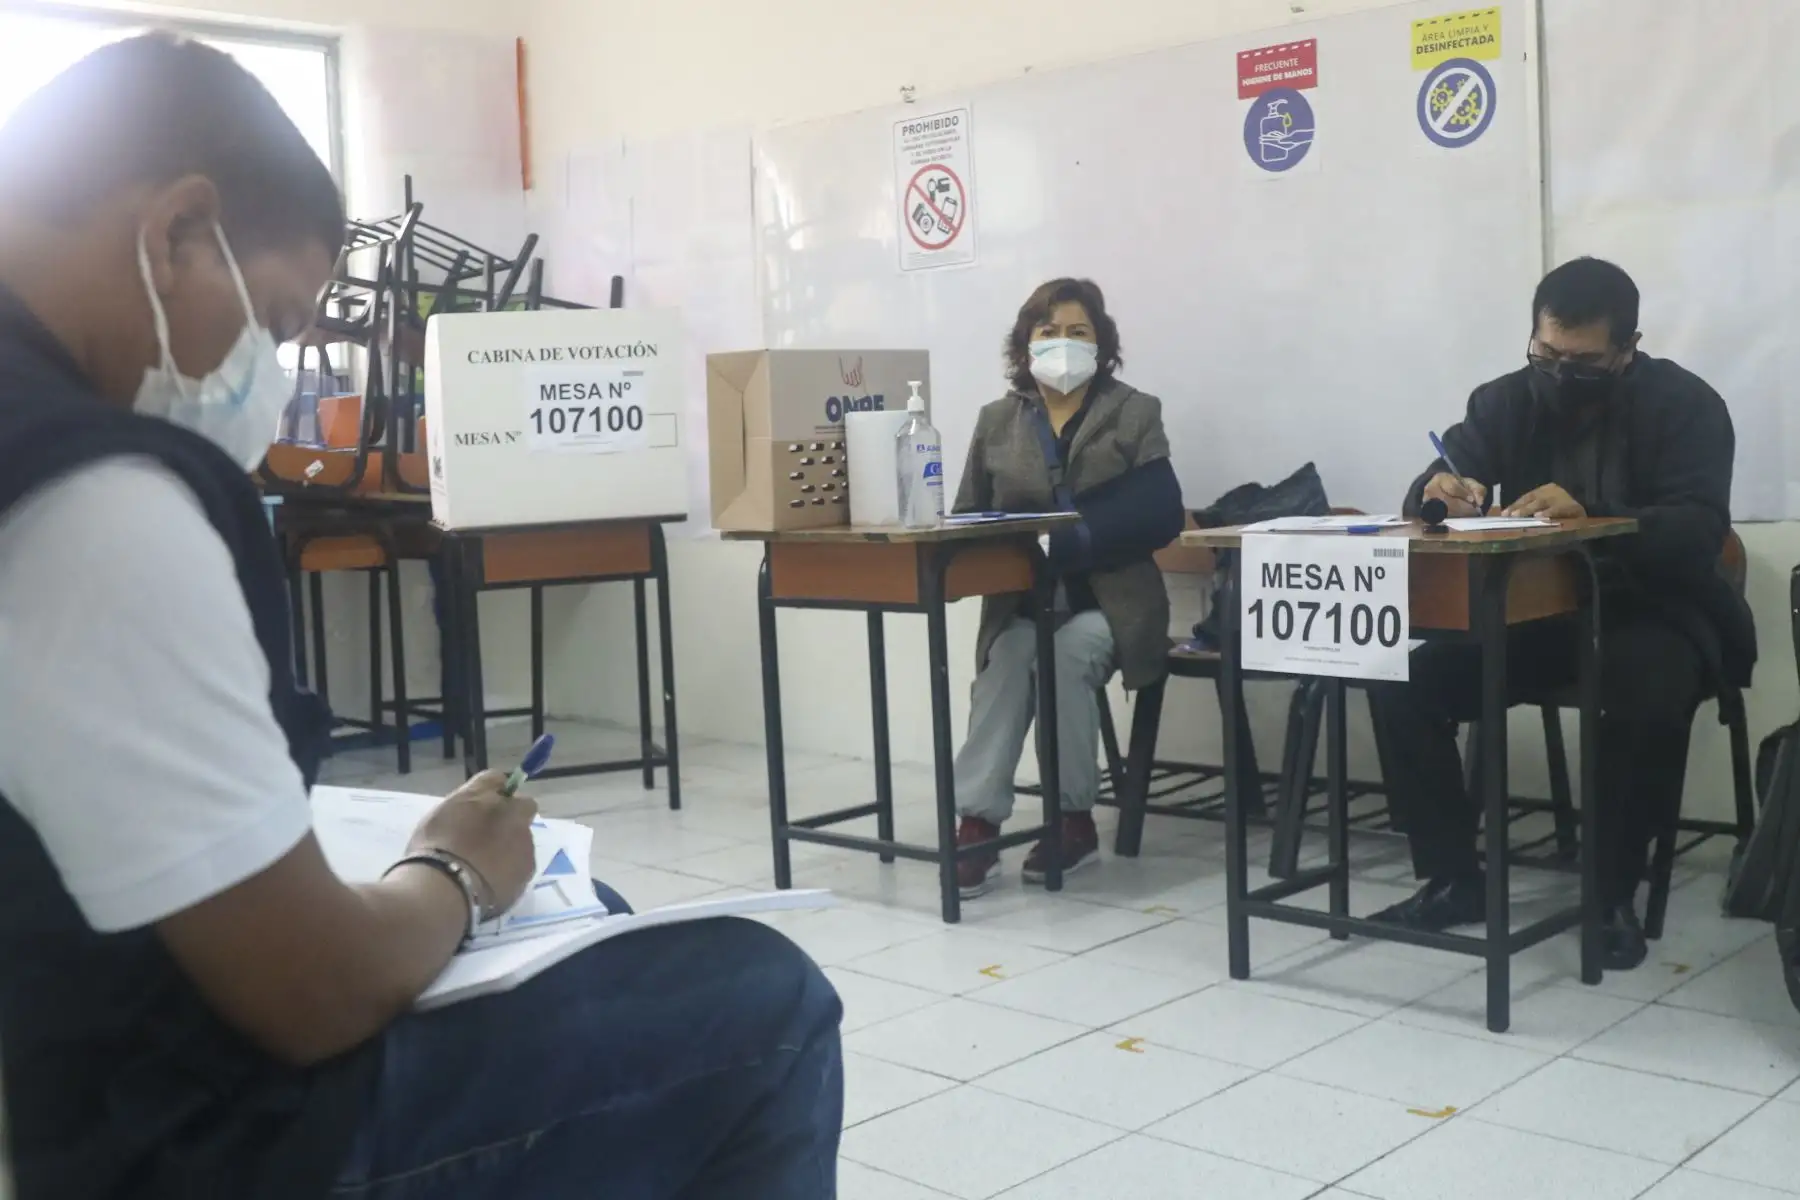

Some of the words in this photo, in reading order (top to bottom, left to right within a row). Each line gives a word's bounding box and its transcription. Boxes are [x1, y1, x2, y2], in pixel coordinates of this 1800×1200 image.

[1483, 23, 1489, 31] Y
[1416, 34, 1494, 54] DESINFECTADA
[1254, 58, 1299, 72] FRECUENTE
[1284, 68, 1313, 79] MANOS
[902, 115, 959, 136] PROHIBIDO
[467, 348, 535, 364] CABINA
[540, 347, 563, 361] DE
[567, 340, 658, 360] VOTACIÓN
[540, 382, 603, 401] MESA
[530, 405, 644, 435] 107100
[454, 432, 501, 446] MESA
[1262, 562, 1345, 591] MESA
[1248, 599, 1401, 648] 107100
